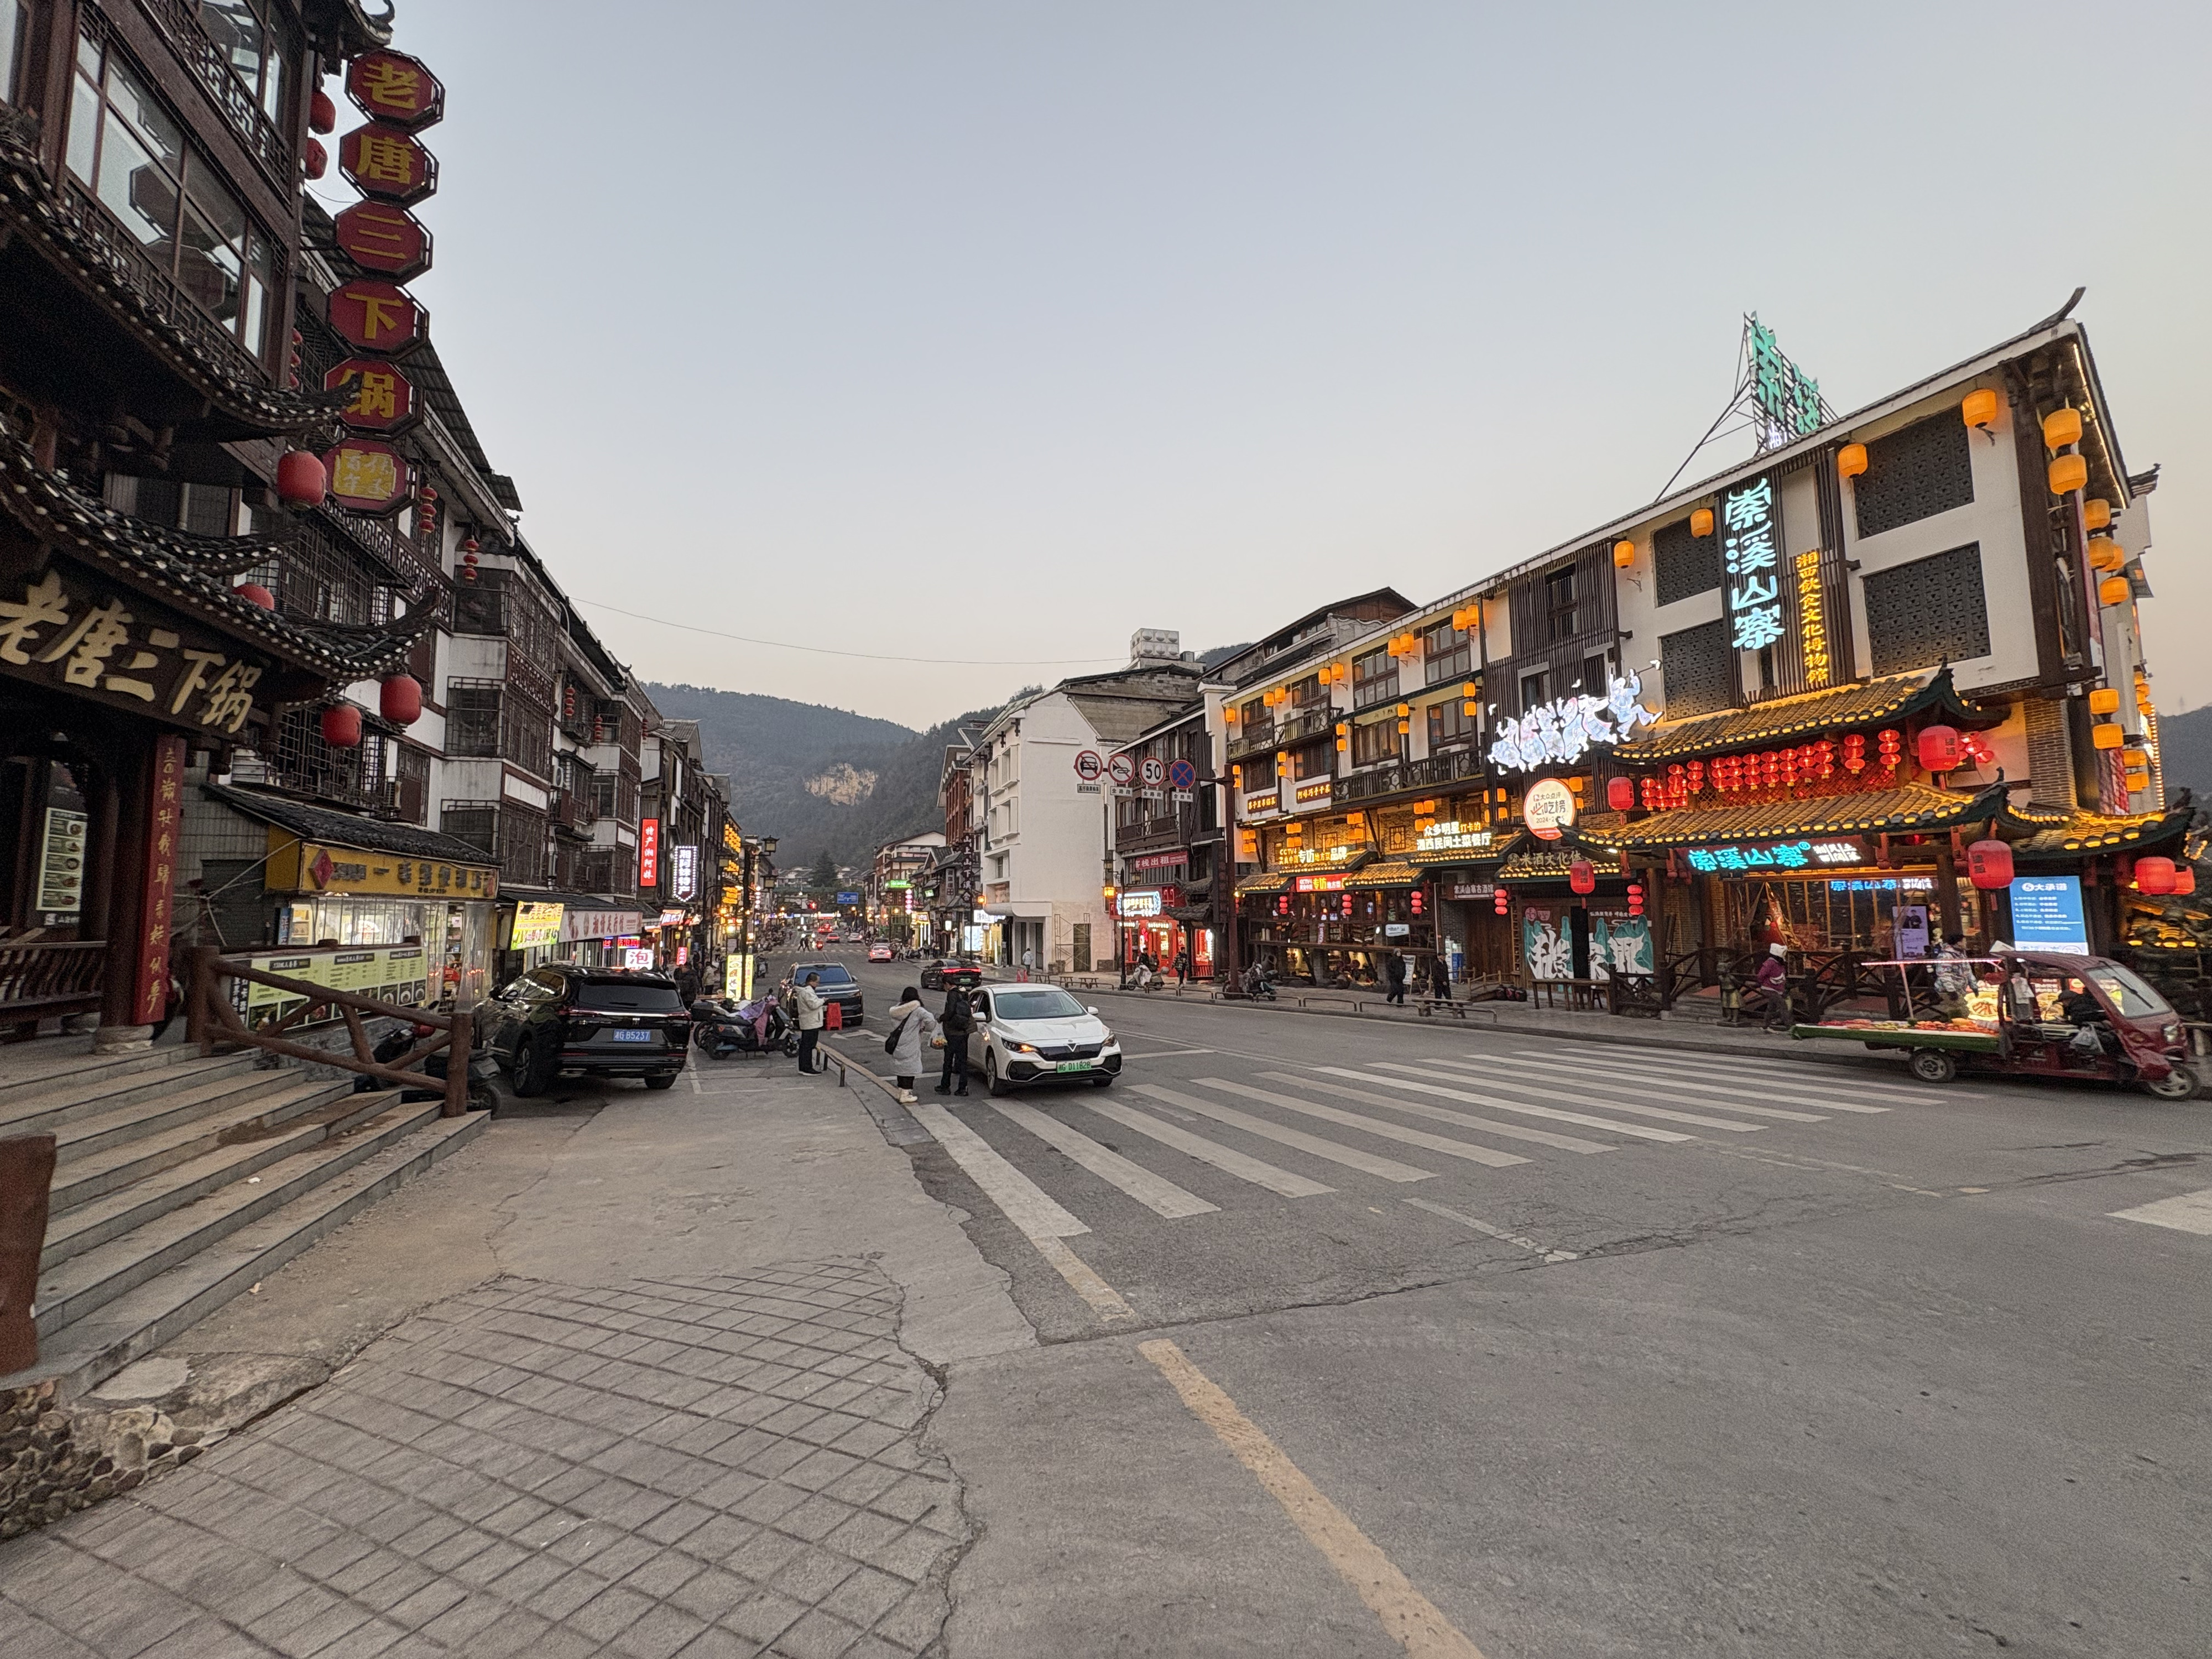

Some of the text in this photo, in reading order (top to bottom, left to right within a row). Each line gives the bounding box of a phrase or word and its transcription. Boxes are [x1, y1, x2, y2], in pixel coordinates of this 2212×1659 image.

[1146, 763, 1161, 780] 50
[1540, 792, 1561, 800] 大众点评
[1530, 800, 1566, 816] 必吃榜
[1424, 821, 1481, 837] 众多明星打卡的
[1417, 832, 1491, 851] 湘西民间土菜餐厅
[1521, 851, 1597, 866] 米酒文化体
[678, 849, 691, 895] 湘阿妹特产
